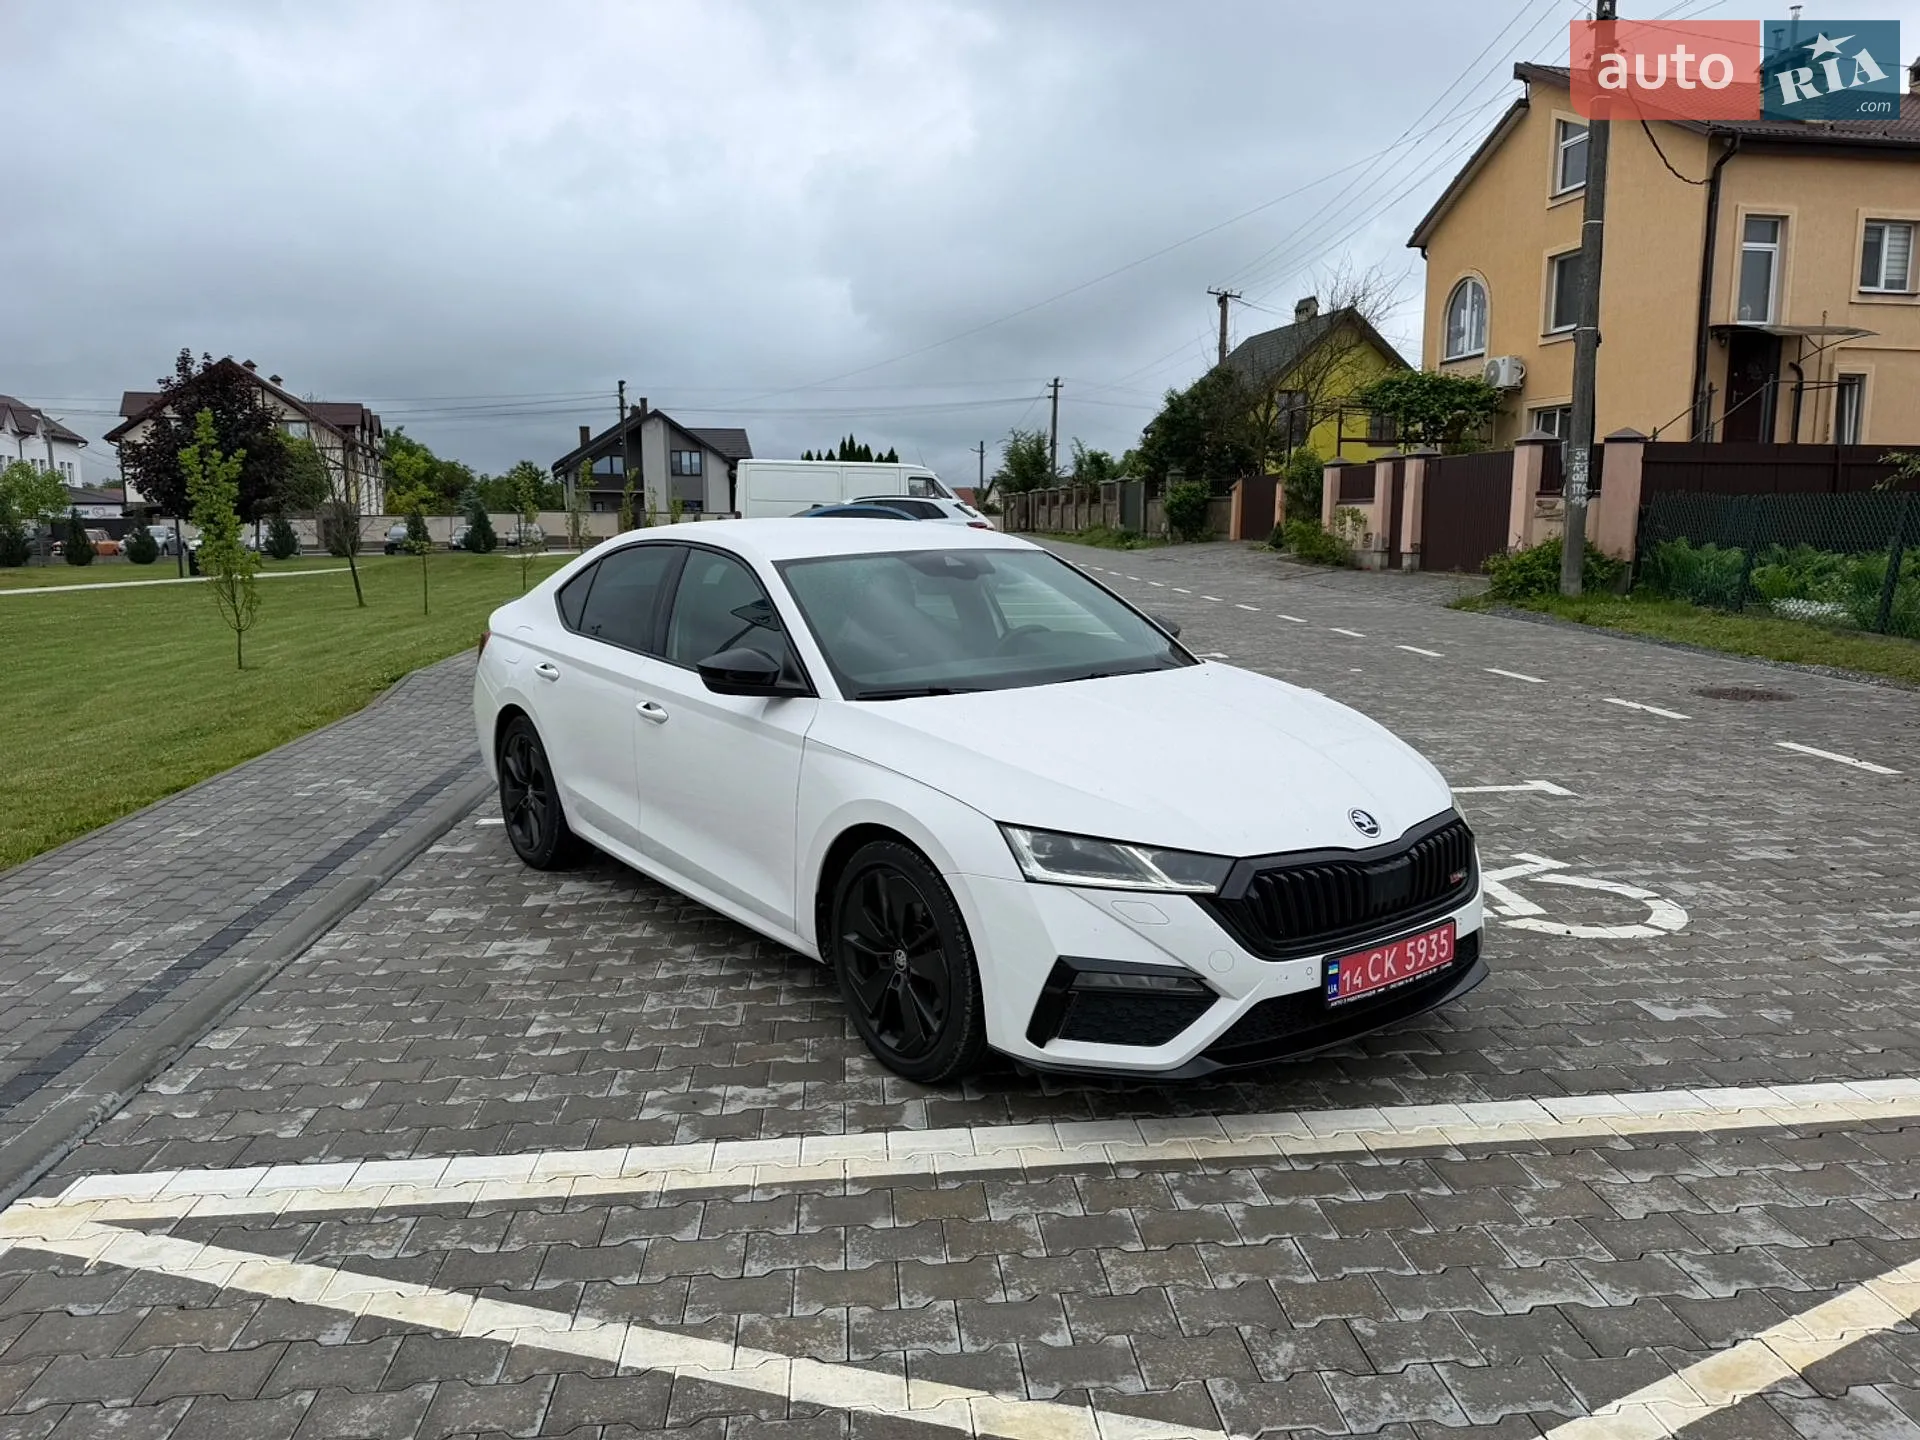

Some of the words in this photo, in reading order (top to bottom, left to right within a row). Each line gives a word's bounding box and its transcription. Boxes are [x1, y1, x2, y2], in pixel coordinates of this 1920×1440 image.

[1342, 966, 1363, 992] 14
[1367, 947, 1397, 983] CK
[1404, 929, 1449, 971] 5935
